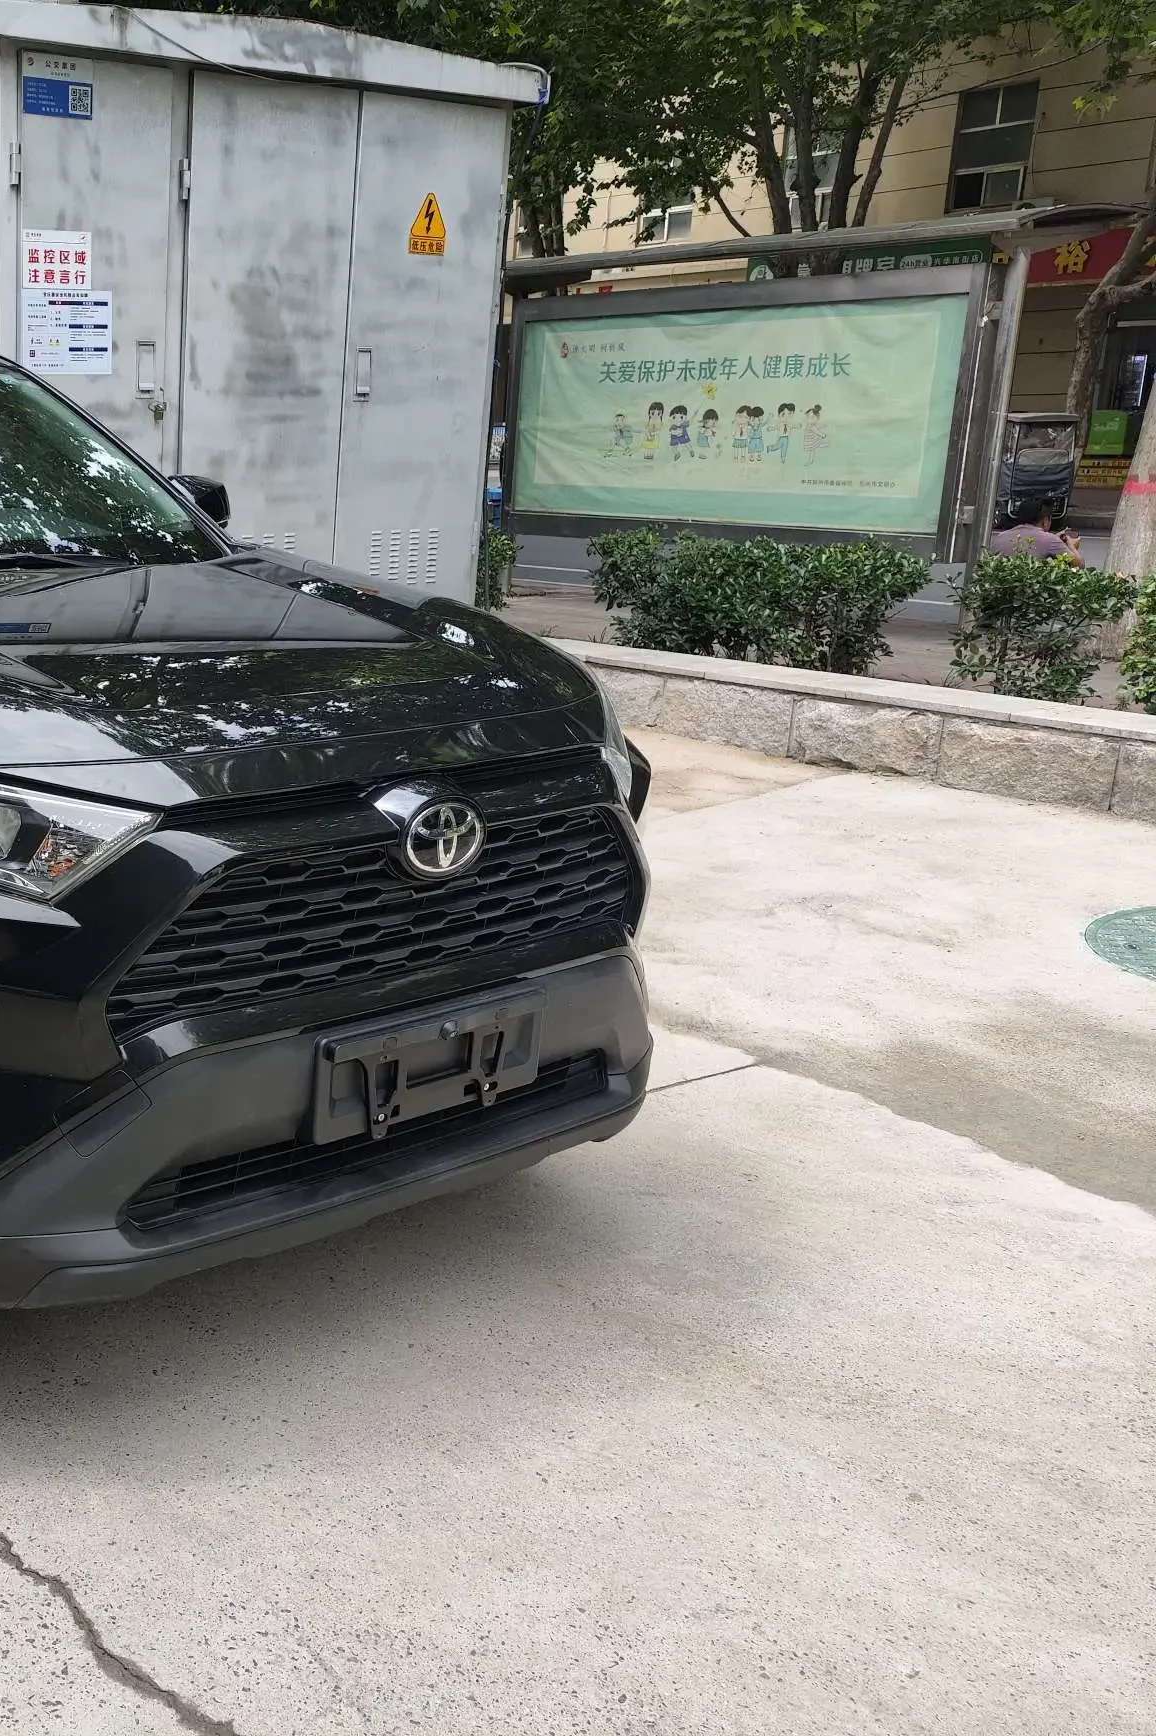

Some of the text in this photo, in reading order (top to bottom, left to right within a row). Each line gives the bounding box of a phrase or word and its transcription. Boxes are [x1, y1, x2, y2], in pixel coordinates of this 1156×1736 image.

[411, 240, 443, 252] 低压危险
[28, 249, 86, 265] 监控区域
[28, 269, 86, 284] 注意言行
[598, 352, 853, 384] 关爱保护未成年人健康成长
